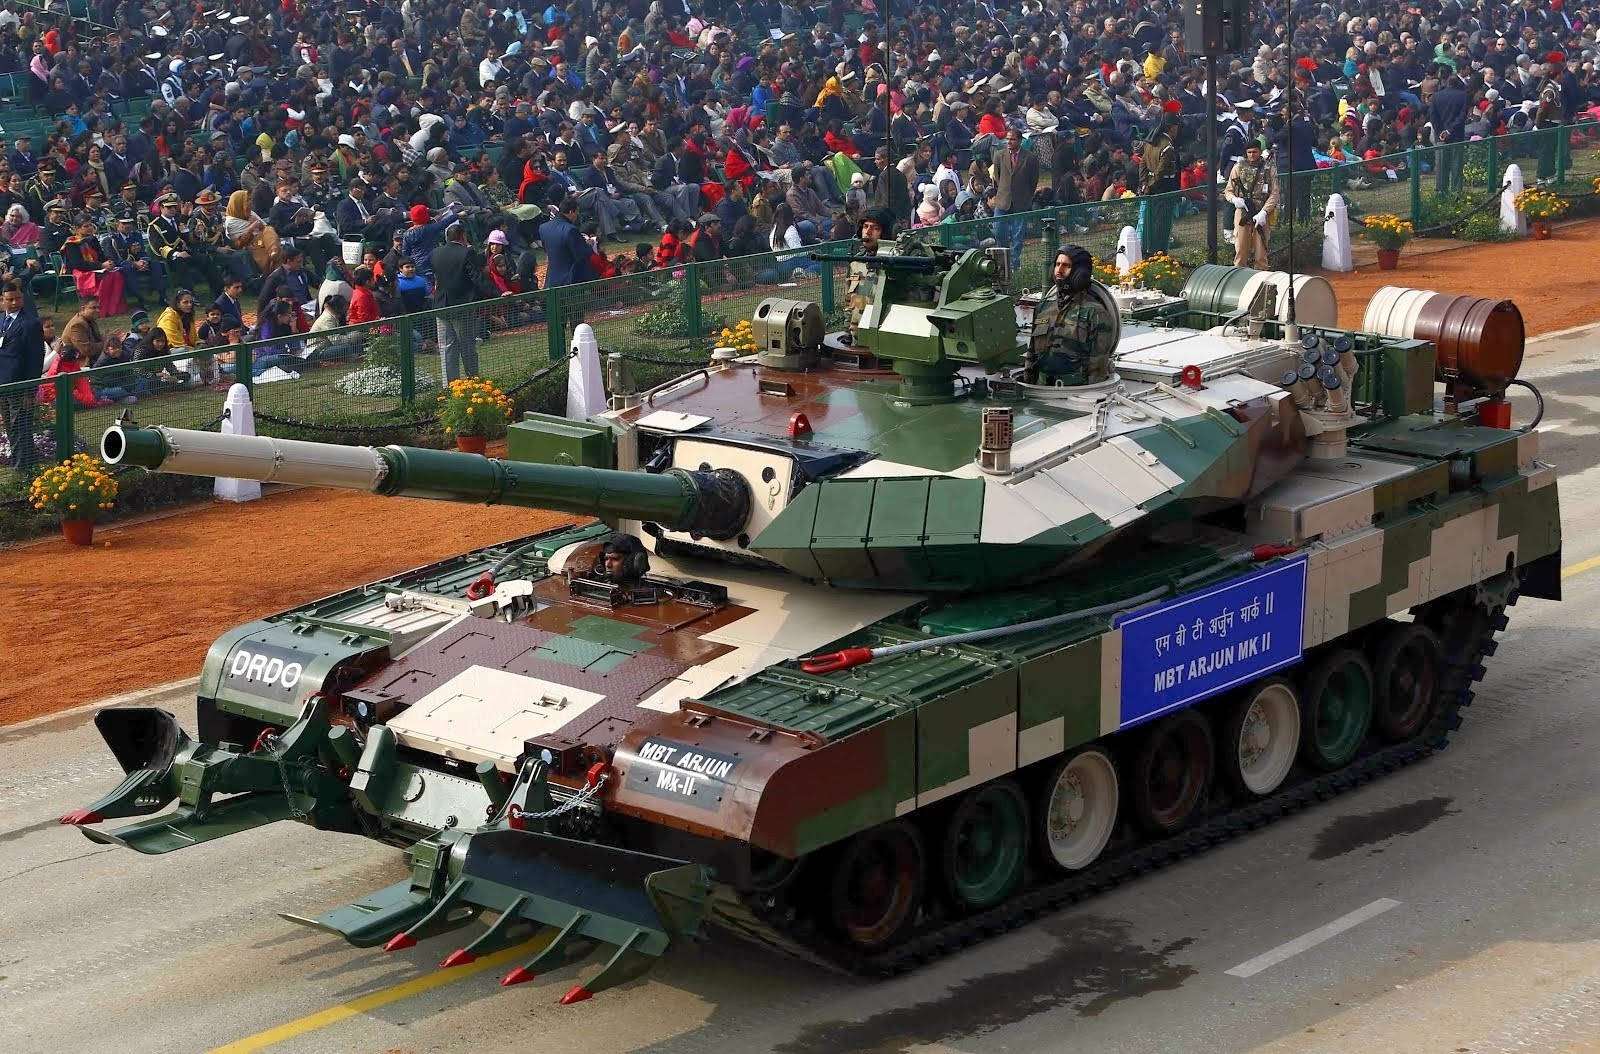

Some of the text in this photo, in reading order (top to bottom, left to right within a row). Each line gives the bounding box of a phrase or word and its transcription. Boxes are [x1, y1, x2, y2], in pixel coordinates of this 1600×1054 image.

[1155, 634, 1170, 657] एम
[1176, 624, 1187, 646] बी
[1192, 618, 1203, 640] टी
[1209, 607, 1234, 637] अर्जुन
[1241, 597, 1261, 622] मार्क
[230, 650, 303, 688] DRDO
[1154, 632, 1270, 692] MBT ARJUN MK II
[638, 742, 733, 778] MBT ARJUN
[656, 770, 695, 796] Mk-II
